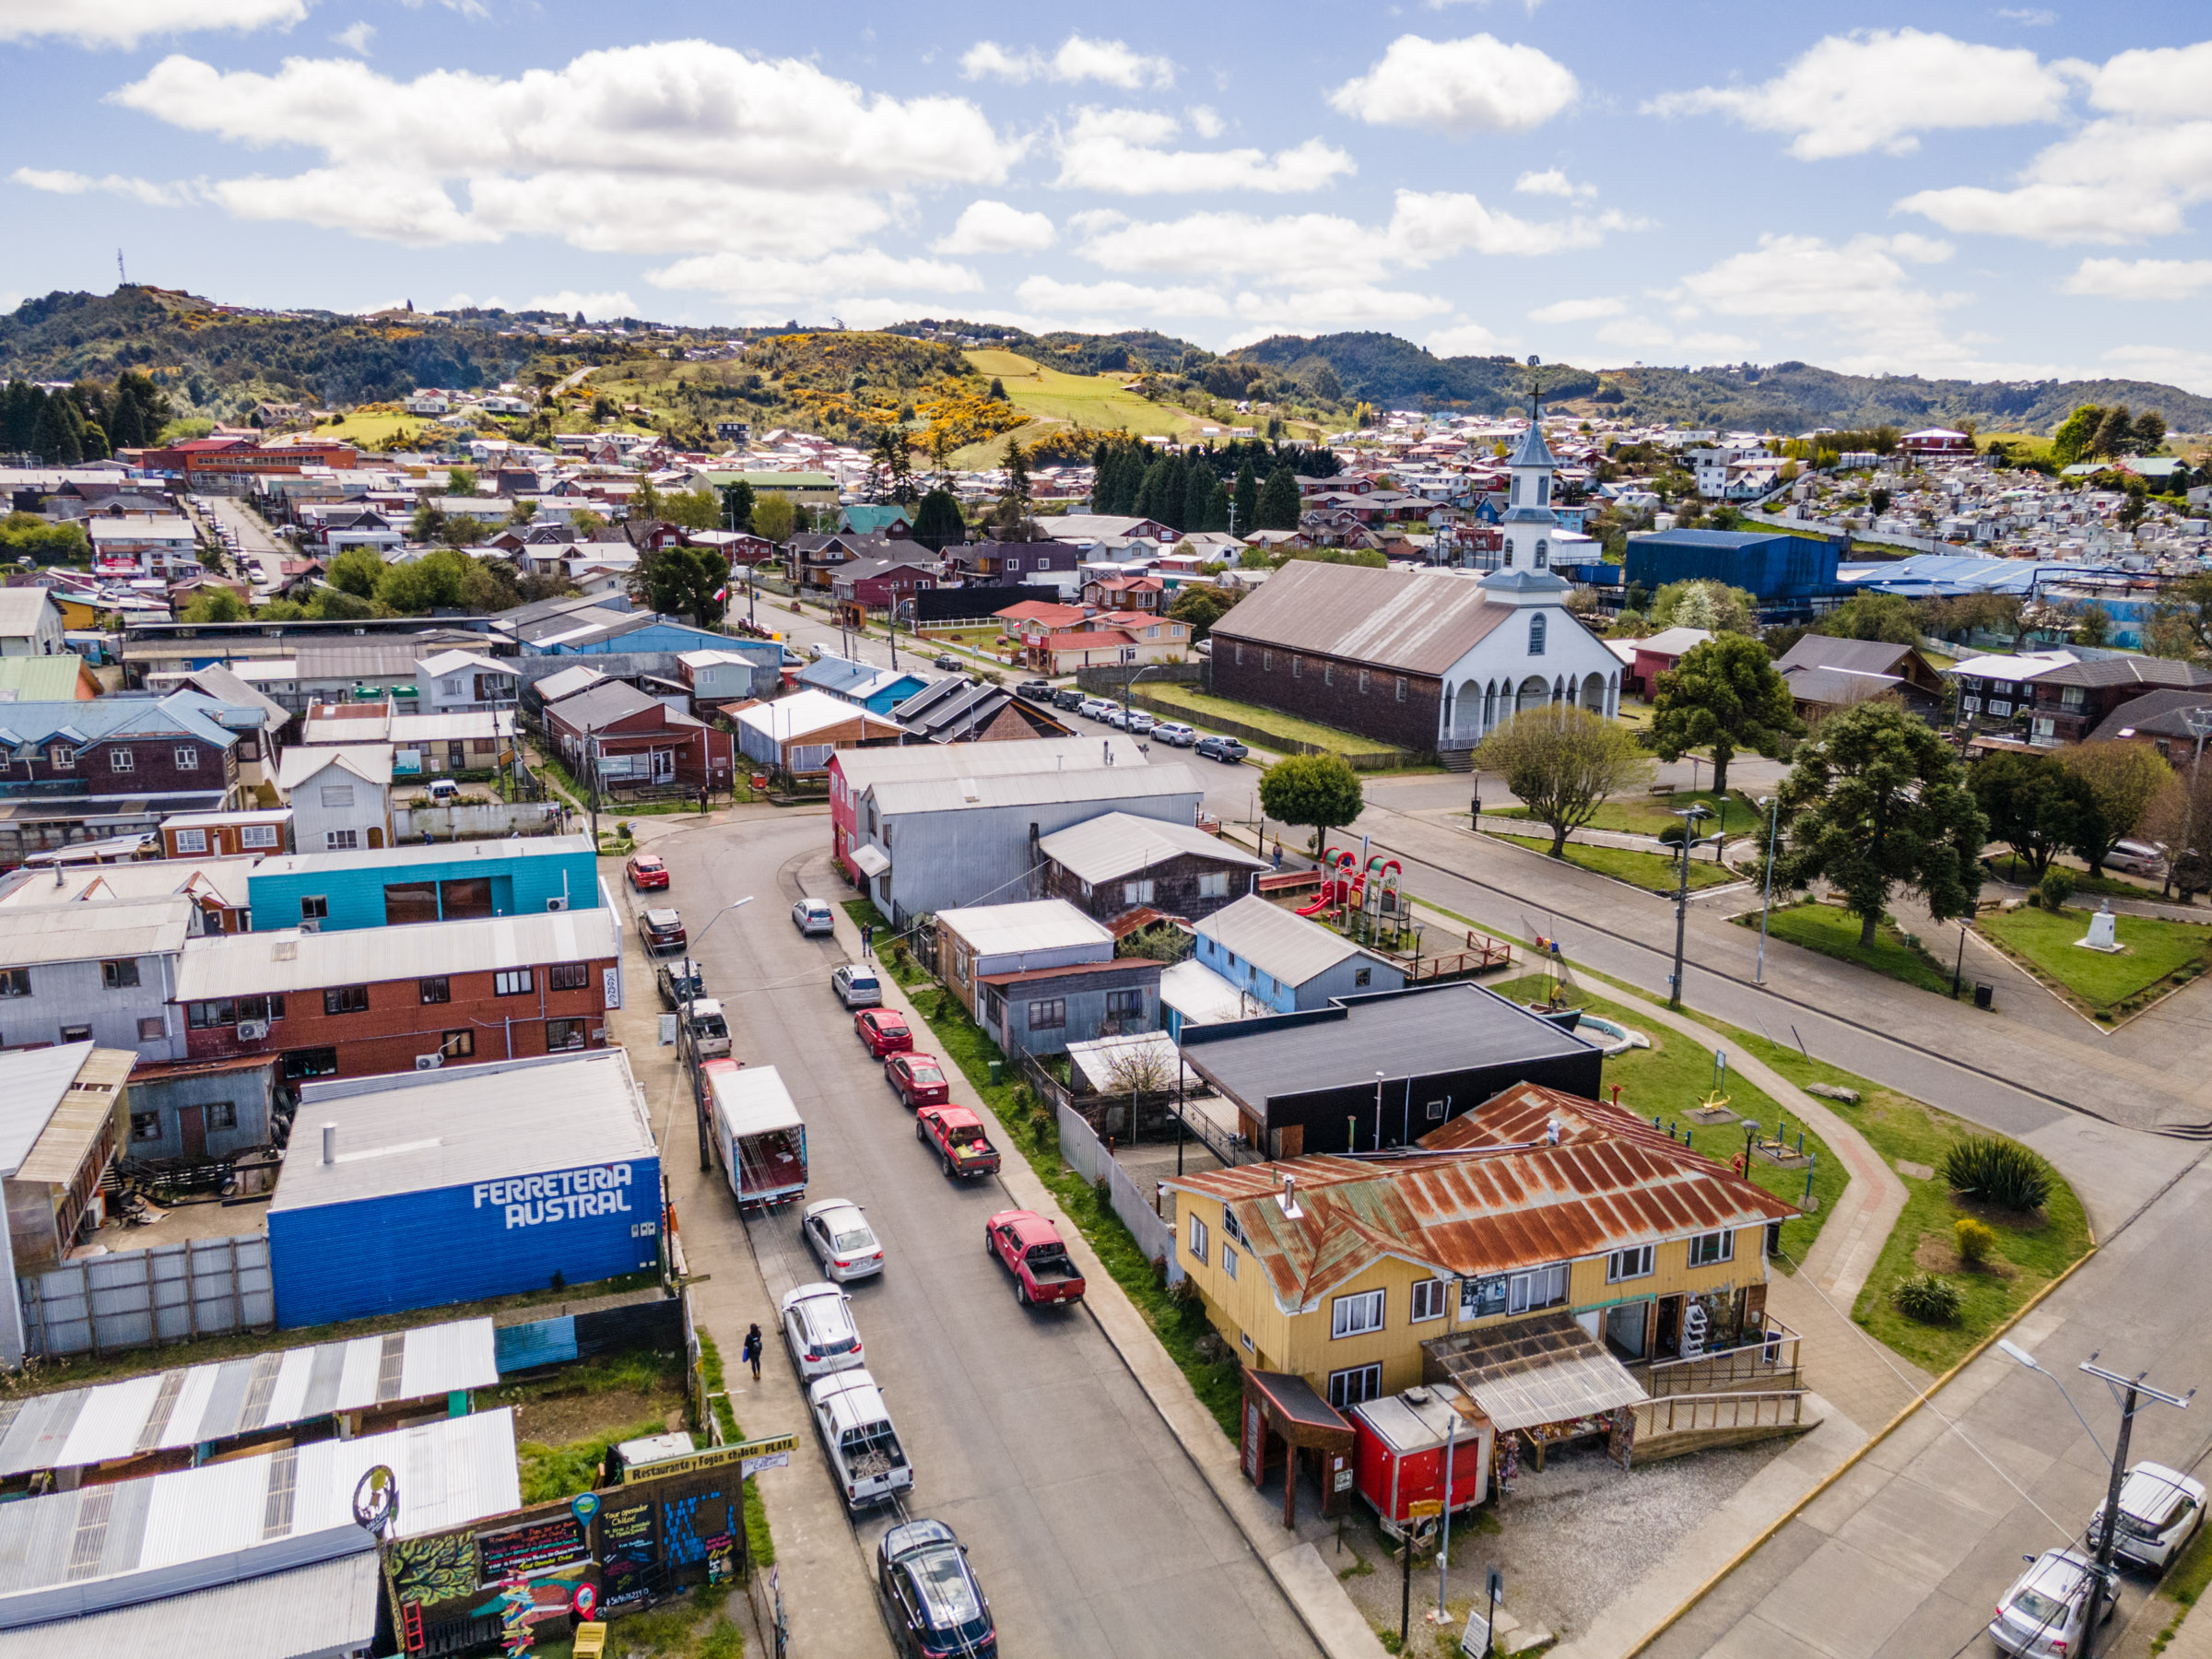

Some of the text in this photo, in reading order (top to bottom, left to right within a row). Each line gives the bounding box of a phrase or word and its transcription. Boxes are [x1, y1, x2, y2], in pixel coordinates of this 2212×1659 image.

[505, 1189, 632, 1230] AUSTRAL
[632, 1458, 689, 1480] Restaurante
[692, 1461, 697, 1472] y
[728, 1446, 759, 1461] chilote
[765, 1439, 793, 1453] PLAYA
[518, 1561, 534, 1571] Tour
